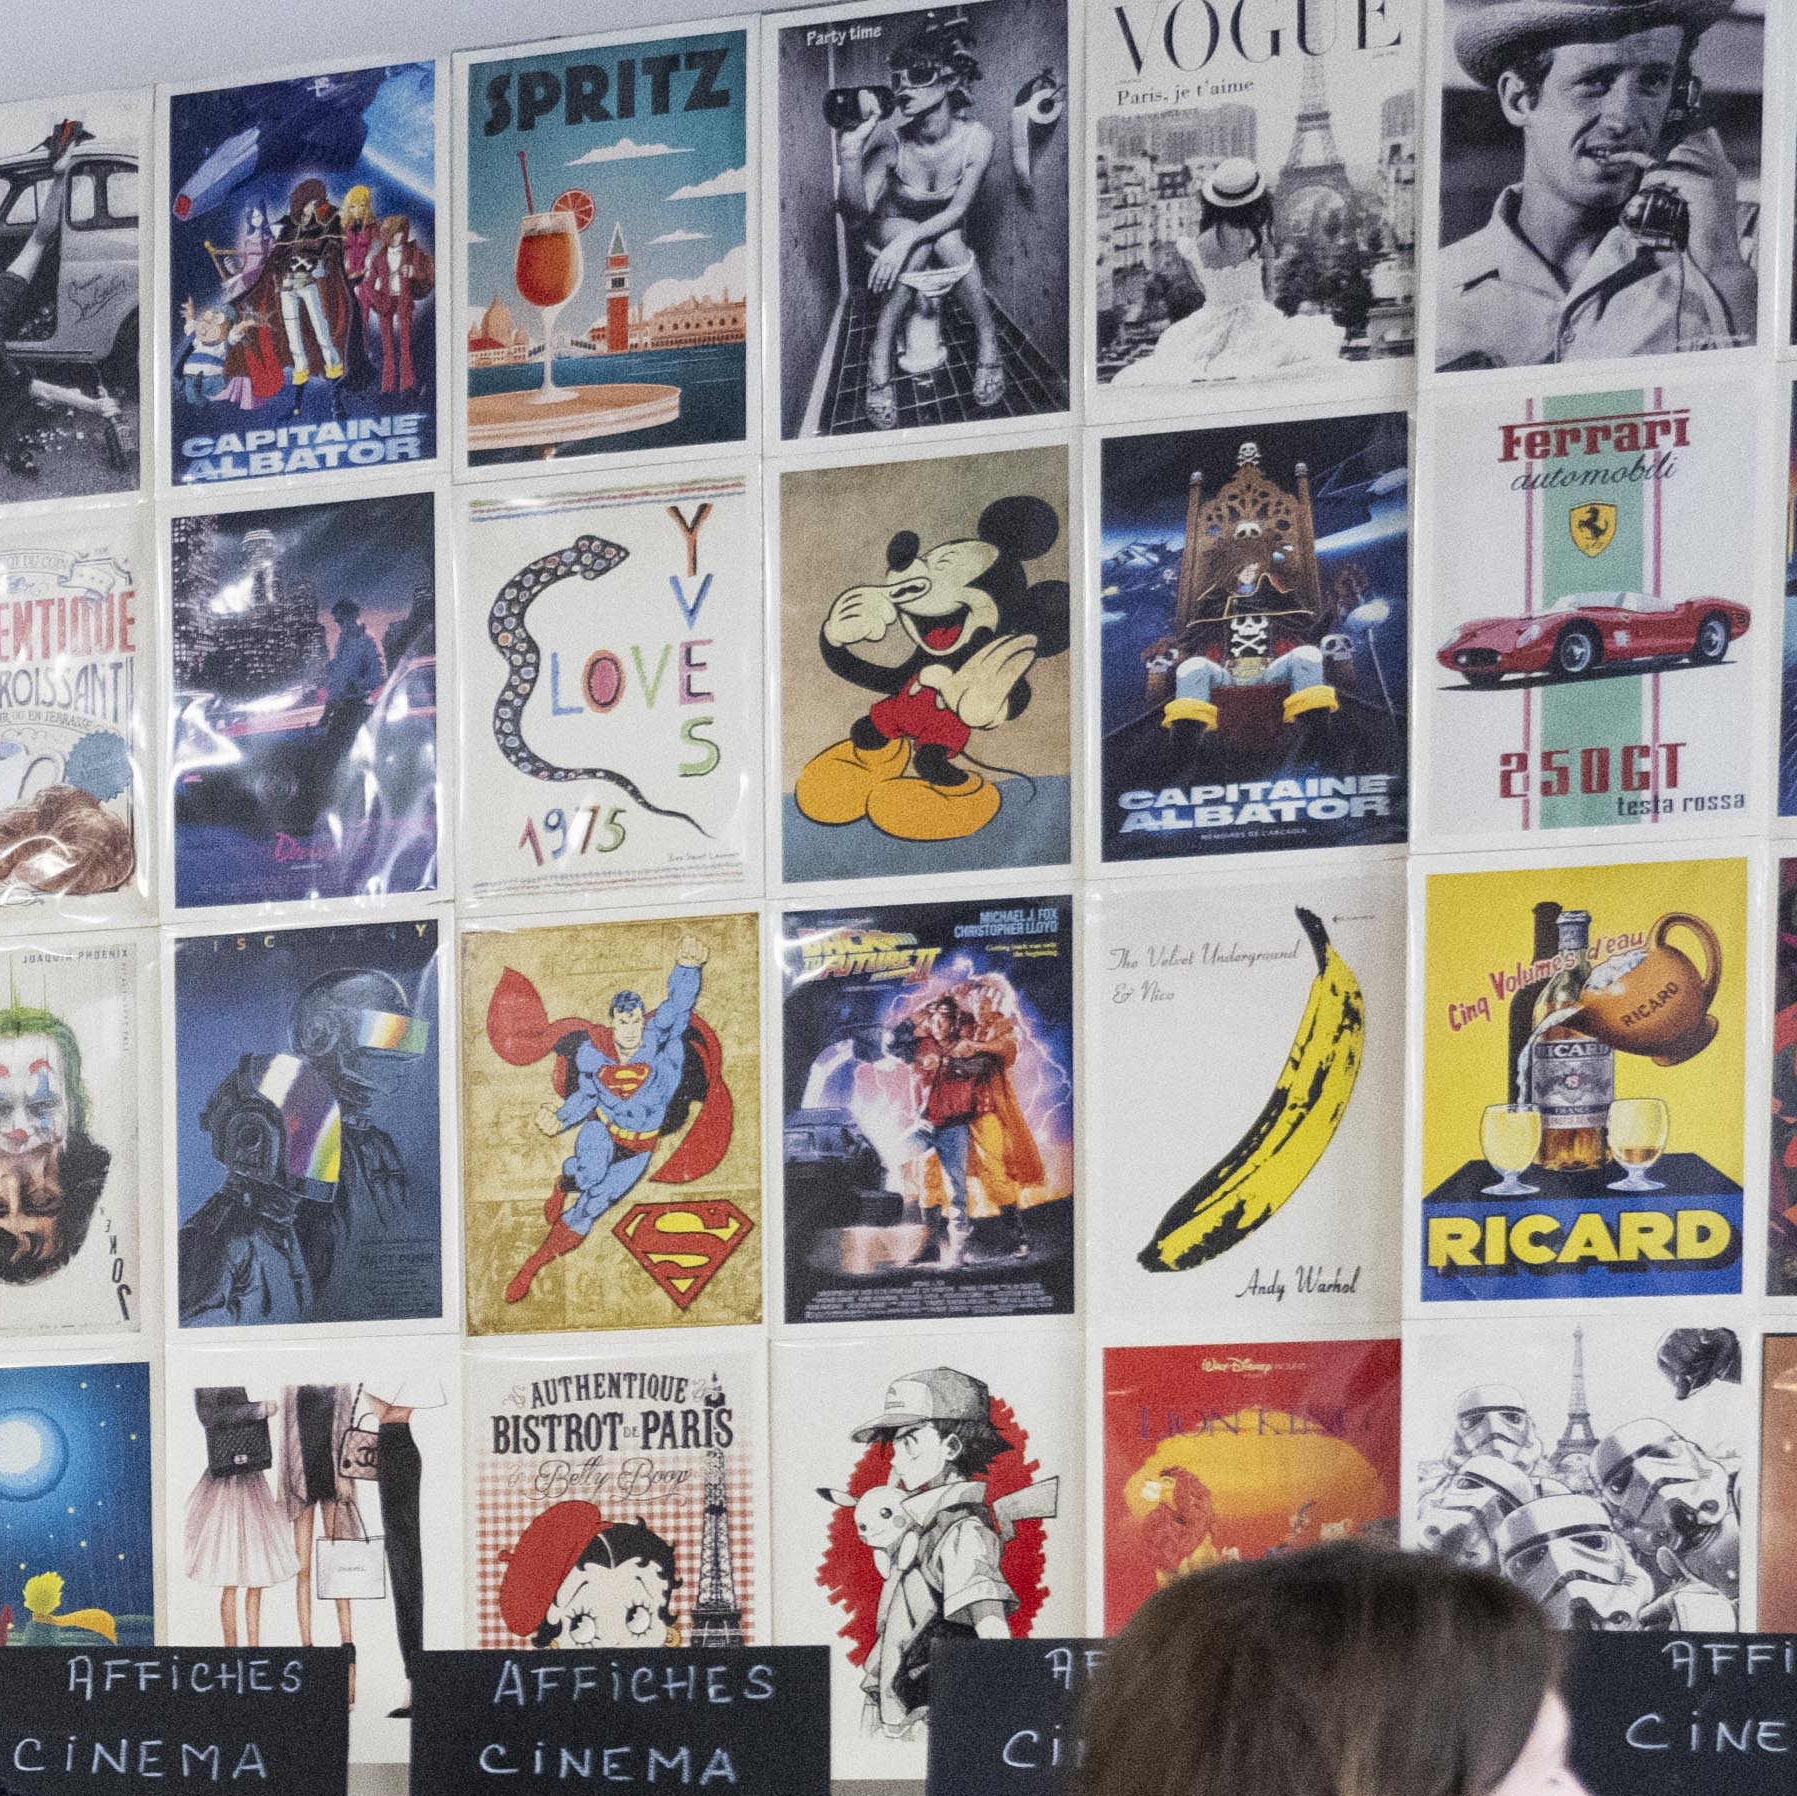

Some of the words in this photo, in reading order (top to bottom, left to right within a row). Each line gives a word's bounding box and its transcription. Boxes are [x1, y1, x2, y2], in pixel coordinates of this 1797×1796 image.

[805, 26, 846, 46] Party
[848, 23, 882, 43] time
[482, 47, 732, 138] SPRITZ
[1198, 77, 1255, 97] t'aime
[181, 413, 421, 459] CAPITAINE
[1498, 408, 1691, 463] Ferrari
[185, 436, 424, 482] ALBATOR
[1510, 451, 1678, 491] automobili
[1118, 773, 1392, 811] CAPITAINE
[1618, 796, 1676, 817] testa
[1682, 793, 1746, 814] rossa
[1119, 794, 1393, 835] ALBATOR
[955, 923, 1024, 938] CHRISTOPHER
[1026, 921, 1059, 936] LLOYD
[980, 910, 1023, 924] MICHAEL
[1037, 908, 1059, 921] FOX
[77, 949, 129, 962] PHOENIX
[1108, 948, 1141, 972] The
[1147, 945, 1195, 969] Velvet
[1200, 942, 1303, 970] Underground
[1143, 980, 1176, 1004] Nico
[1447, 996, 1492, 1034] Cinq
[1488, 951, 1579, 1002] Volumes
[1587, 929, 1648, 962] d'eau
[1620, 979, 1680, 1028] RICARD
[1427, 1209, 1733, 1270] RICARD
[1234, 1266, 1287, 1300] Andy
[1296, 1266, 1361, 1296] Warhol
[1201, 1359, 1231, 1374] Walt
[1227, 1357, 1273, 1375] Disney
[531, 1372, 689, 1409] AUTHENTIQUE
[491, 1411, 624, 1454] BISTROT
[640, 1407, 734, 1450] PARIS
[525, 1455, 610, 1501] Betty
[609, 1456, 693, 1506] Boop
